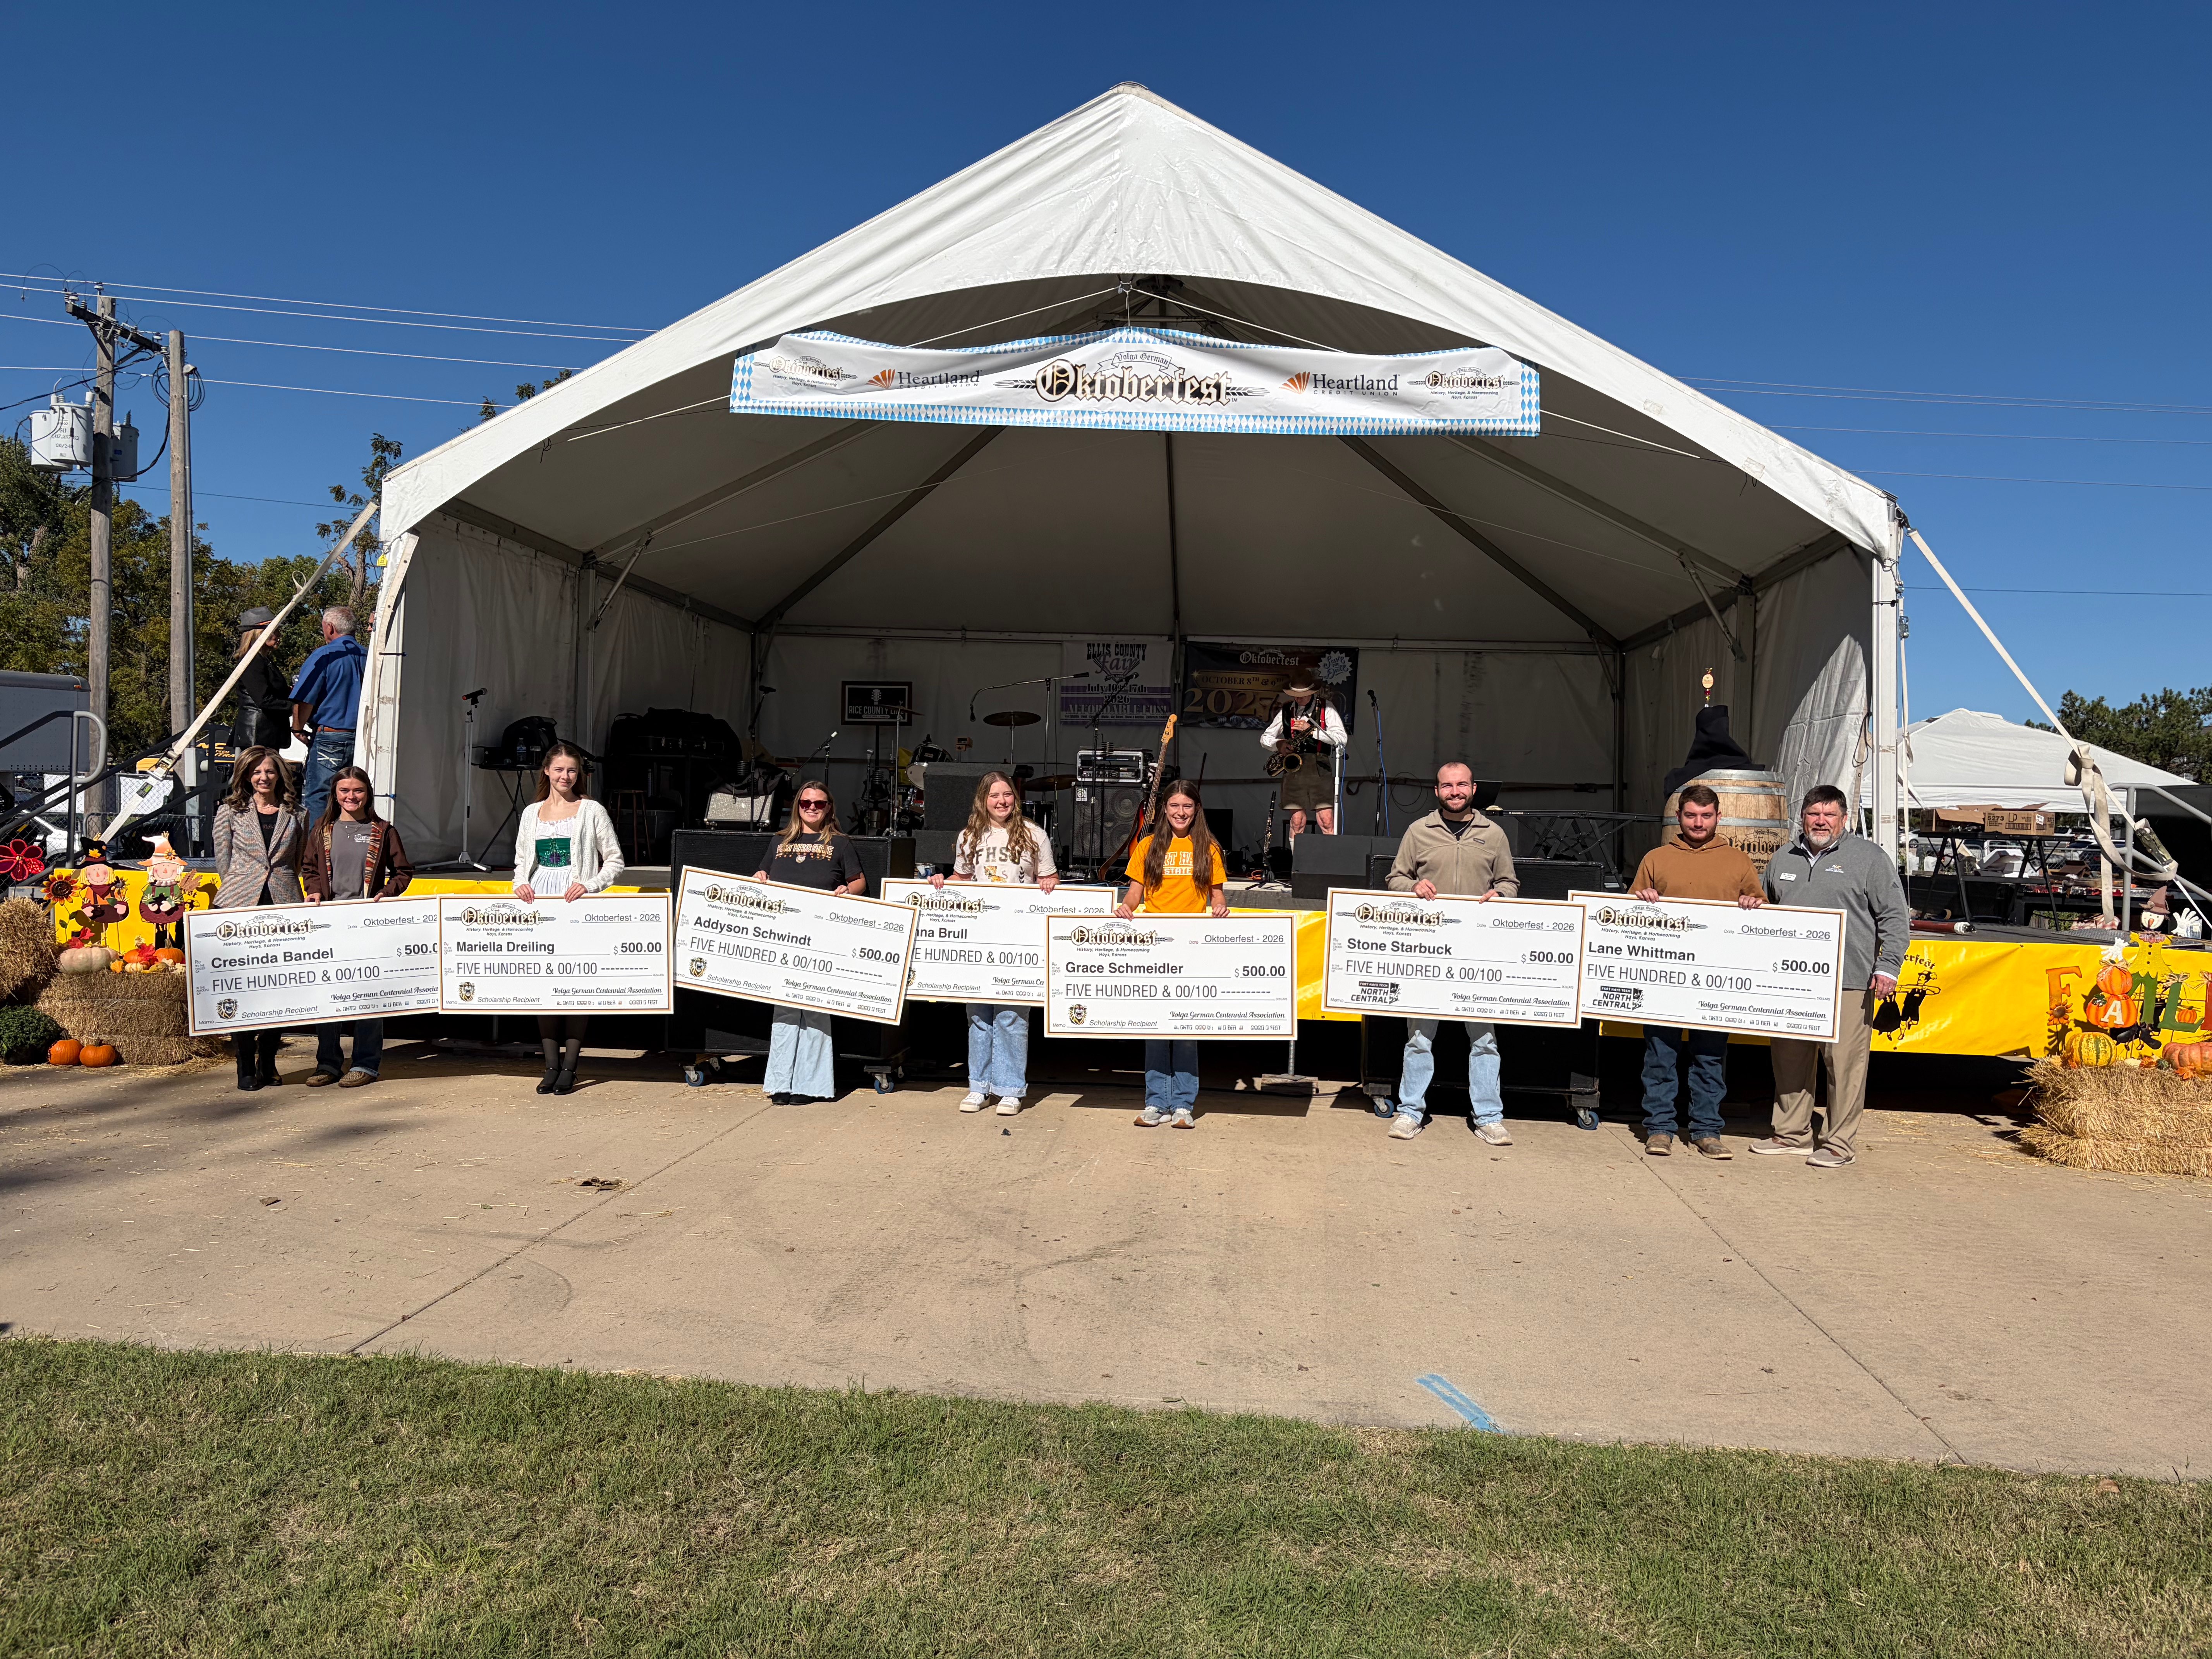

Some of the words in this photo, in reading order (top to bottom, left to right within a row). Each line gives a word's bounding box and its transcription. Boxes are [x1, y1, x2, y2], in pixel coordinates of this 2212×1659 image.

[1140, 354, 1168, 365] German
[769, 356, 843, 381] Oktoberfest
[898, 370, 980, 385] Heartland
[1036, 359, 1232, 406] Oktoberfest
[1312, 374, 1398, 390] Heartland
[1425, 371, 1505, 389] Oktoberfest
[1087, 643, 1111, 660] ELLIS
[1115, 644, 1147, 661] COUNTY
[1240, 651, 1299, 666] Oktoberfest
[1095, 654, 1137, 674] Fair
[1202, 677, 1245, 685] OCTOBER
[1086, 684, 1105, 694] July
[864, 706, 888, 714] COUNTY
[1067, 704, 1140, 715] AFFORDABLE
[1183, 688, 1279, 722] 2027
[1163, 852, 1177, 866] RT
[1179, 851, 1193, 866] HA
[704, 883, 787, 915] Oktoberfest
[905, 891, 985, 914] Oktoberfest
[460, 906, 541, 926] Oktoberfest
[1029, 905, 1076, 913] Oktoberfest
[1355, 903, 1444, 927] Oktoberfest
[364, 916, 414, 926] Oktoberfest
[585, 914, 632, 922] Oktoberfest
[640, 914, 660, 922] 2026
[829, 912, 876, 928] Oktoberfest
[883, 921, 904, 932] 2026
[1492, 918, 1544, 929] Oktoberfest
[1552, 922, 1574, 931] 2026
[1596, 906, 1690, 933] Oktoberfest
[216, 918, 313, 941] Oktoberfest
[694, 916, 749, 939] Addyson
[752, 926, 812, 946] Schwindt
[916, 929, 934, 938] nna
[939, 928, 967, 939] Brull
[1070, 926, 1158, 946] Oktoberfest
[1741, 925, 1796, 937] Oktoberfest
[1806, 930, 1831, 939] 2026
[1205, 934, 1253, 943] Oktoberfest
[1262, 935, 1284, 943] 2026
[397, 948, 402, 957] $
[405, 943, 438, 955] 500.0
[457, 941, 503, 952] Mariella
[507, 941, 555, 954] Dreiling
[613, 946, 618, 955] $
[621, 942, 662, 953] 500.00
[1347, 938, 1386, 951] Stone
[1391, 941, 1452, 955] Starbuck
[1589, 942, 1622, 955] Lane
[1627, 944, 1695, 962] Whittman
[211, 953, 278, 969] Cresinda
[283, 948, 333, 962] Bandel
[690, 936, 716, 953] FIVE
[718, 941, 776, 963] HUNDRED
[780, 952, 789, 965] &
[793, 954, 833, 973] 00/100
[852, 948, 857, 958] $
[859, 947, 900, 964] 500.00
[925, 948, 982, 963] HUNDRED
[987, 951, 995, 963] &
[999, 951, 1039, 965] 00/100
[1521, 953, 1527, 964] $
[1529, 951, 1574, 964] 500.00
[1904, 954, 1936, 969] erfest
[457, 962, 480, 974] FIVE
[484, 962, 541, 974] HUNDRED
[546, 962, 554, 975] &
[558, 962, 597, 975] 00/100
[1066, 962, 1104, 974] Grace
[1108, 962, 1183, 974] Schmeidler
[1234, 968, 1239, 978] $
[1242, 965, 1285, 977] 500.00
[1346, 960, 1373, 973] FIVE
[1377, 962, 1441, 978] HUNDRED
[1445, 966, 1455, 979] &
[1459, 968, 1502, 982] 00/100
[1772, 962, 1778, 973] $
[1781, 959, 1830, 974] 500.00
[213, 977, 242, 992] FIVE
[247, 971, 316, 988] HUNDRED
[321, 970, 331, 982] &
[336, 966, 380, 981] 00/100
[1587, 964, 1614, 979] FIVE
[1620, 967, 1686, 985] HUNDRED
[1692, 974, 1701, 986] &
[1706, 974, 1752, 991] 00/100
[1066, 984, 1091, 997] FIVE
[1096, 984, 1157, 998] HUNDRED
[1162, 985, 1171, 998] &
[1176, 985, 1217, 998] 00/100
[1351, 994, 1388, 1003] CENTRAL
[1361, 988, 1389, 996] NORTH
[1602, 993, 1632, 1001] NORTH
[242, 1008, 283, 1018] Scholarship
[285, 1005, 318, 1015] Recipient
[1592, 999, 1632, 1009] CENTRAL
[1170, 1011, 1188, 1020] Volga
